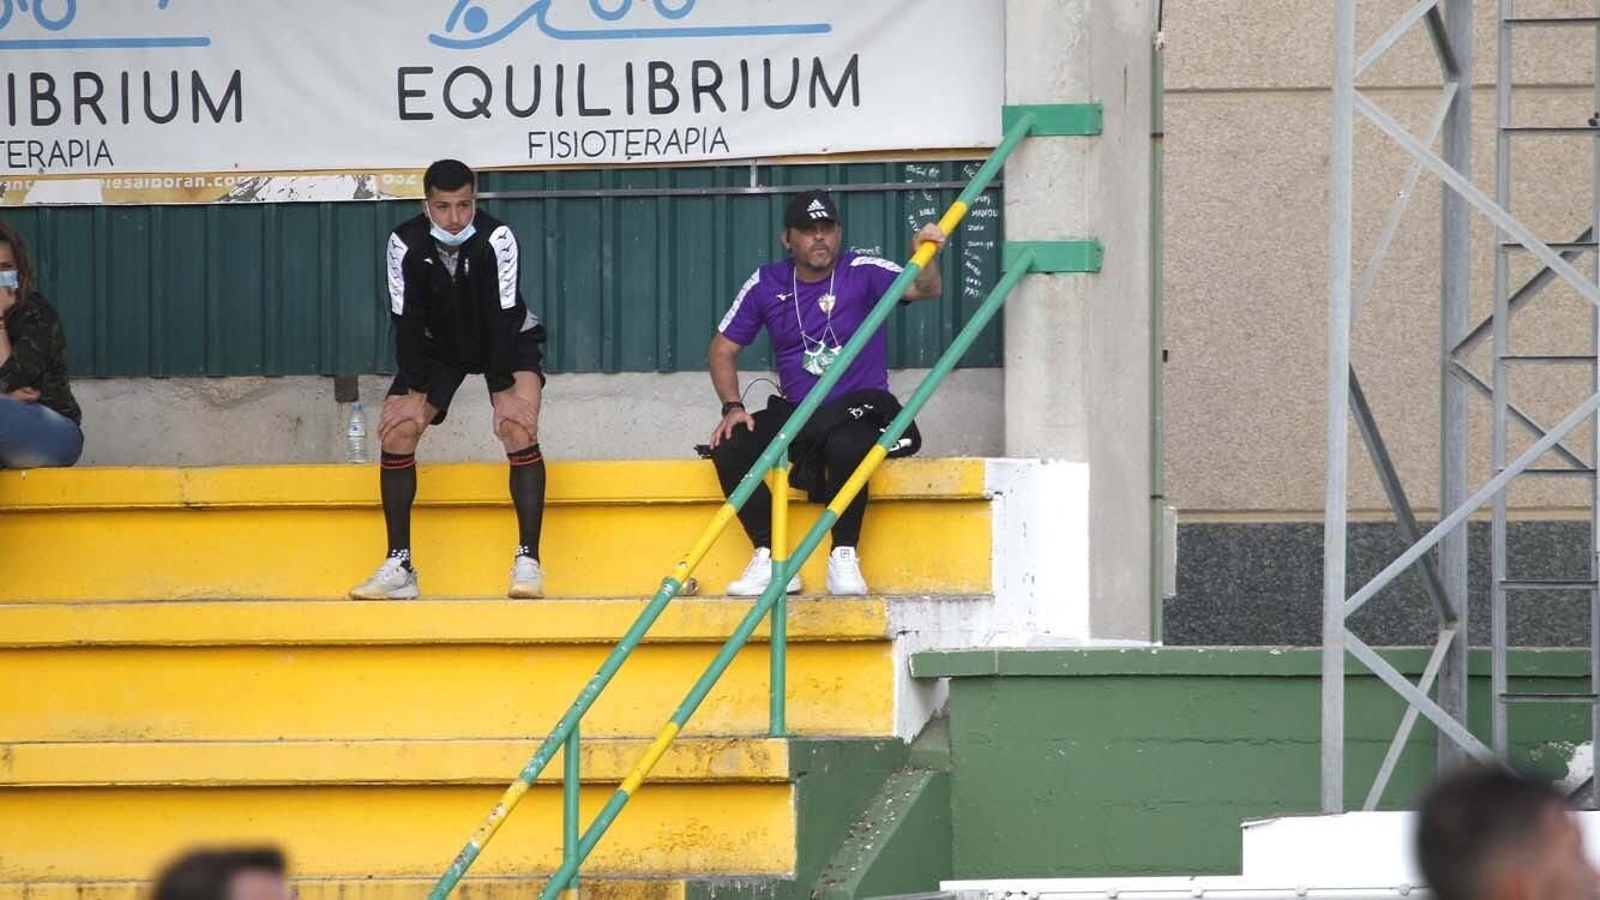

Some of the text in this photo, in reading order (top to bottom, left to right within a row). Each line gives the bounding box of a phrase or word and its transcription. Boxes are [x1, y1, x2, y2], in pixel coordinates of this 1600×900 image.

[7, 69, 243, 127] IBRIUM
[398, 53, 861, 121] EQUILIBRIUM
[528, 126, 730, 159] FISIOTERAPIA
